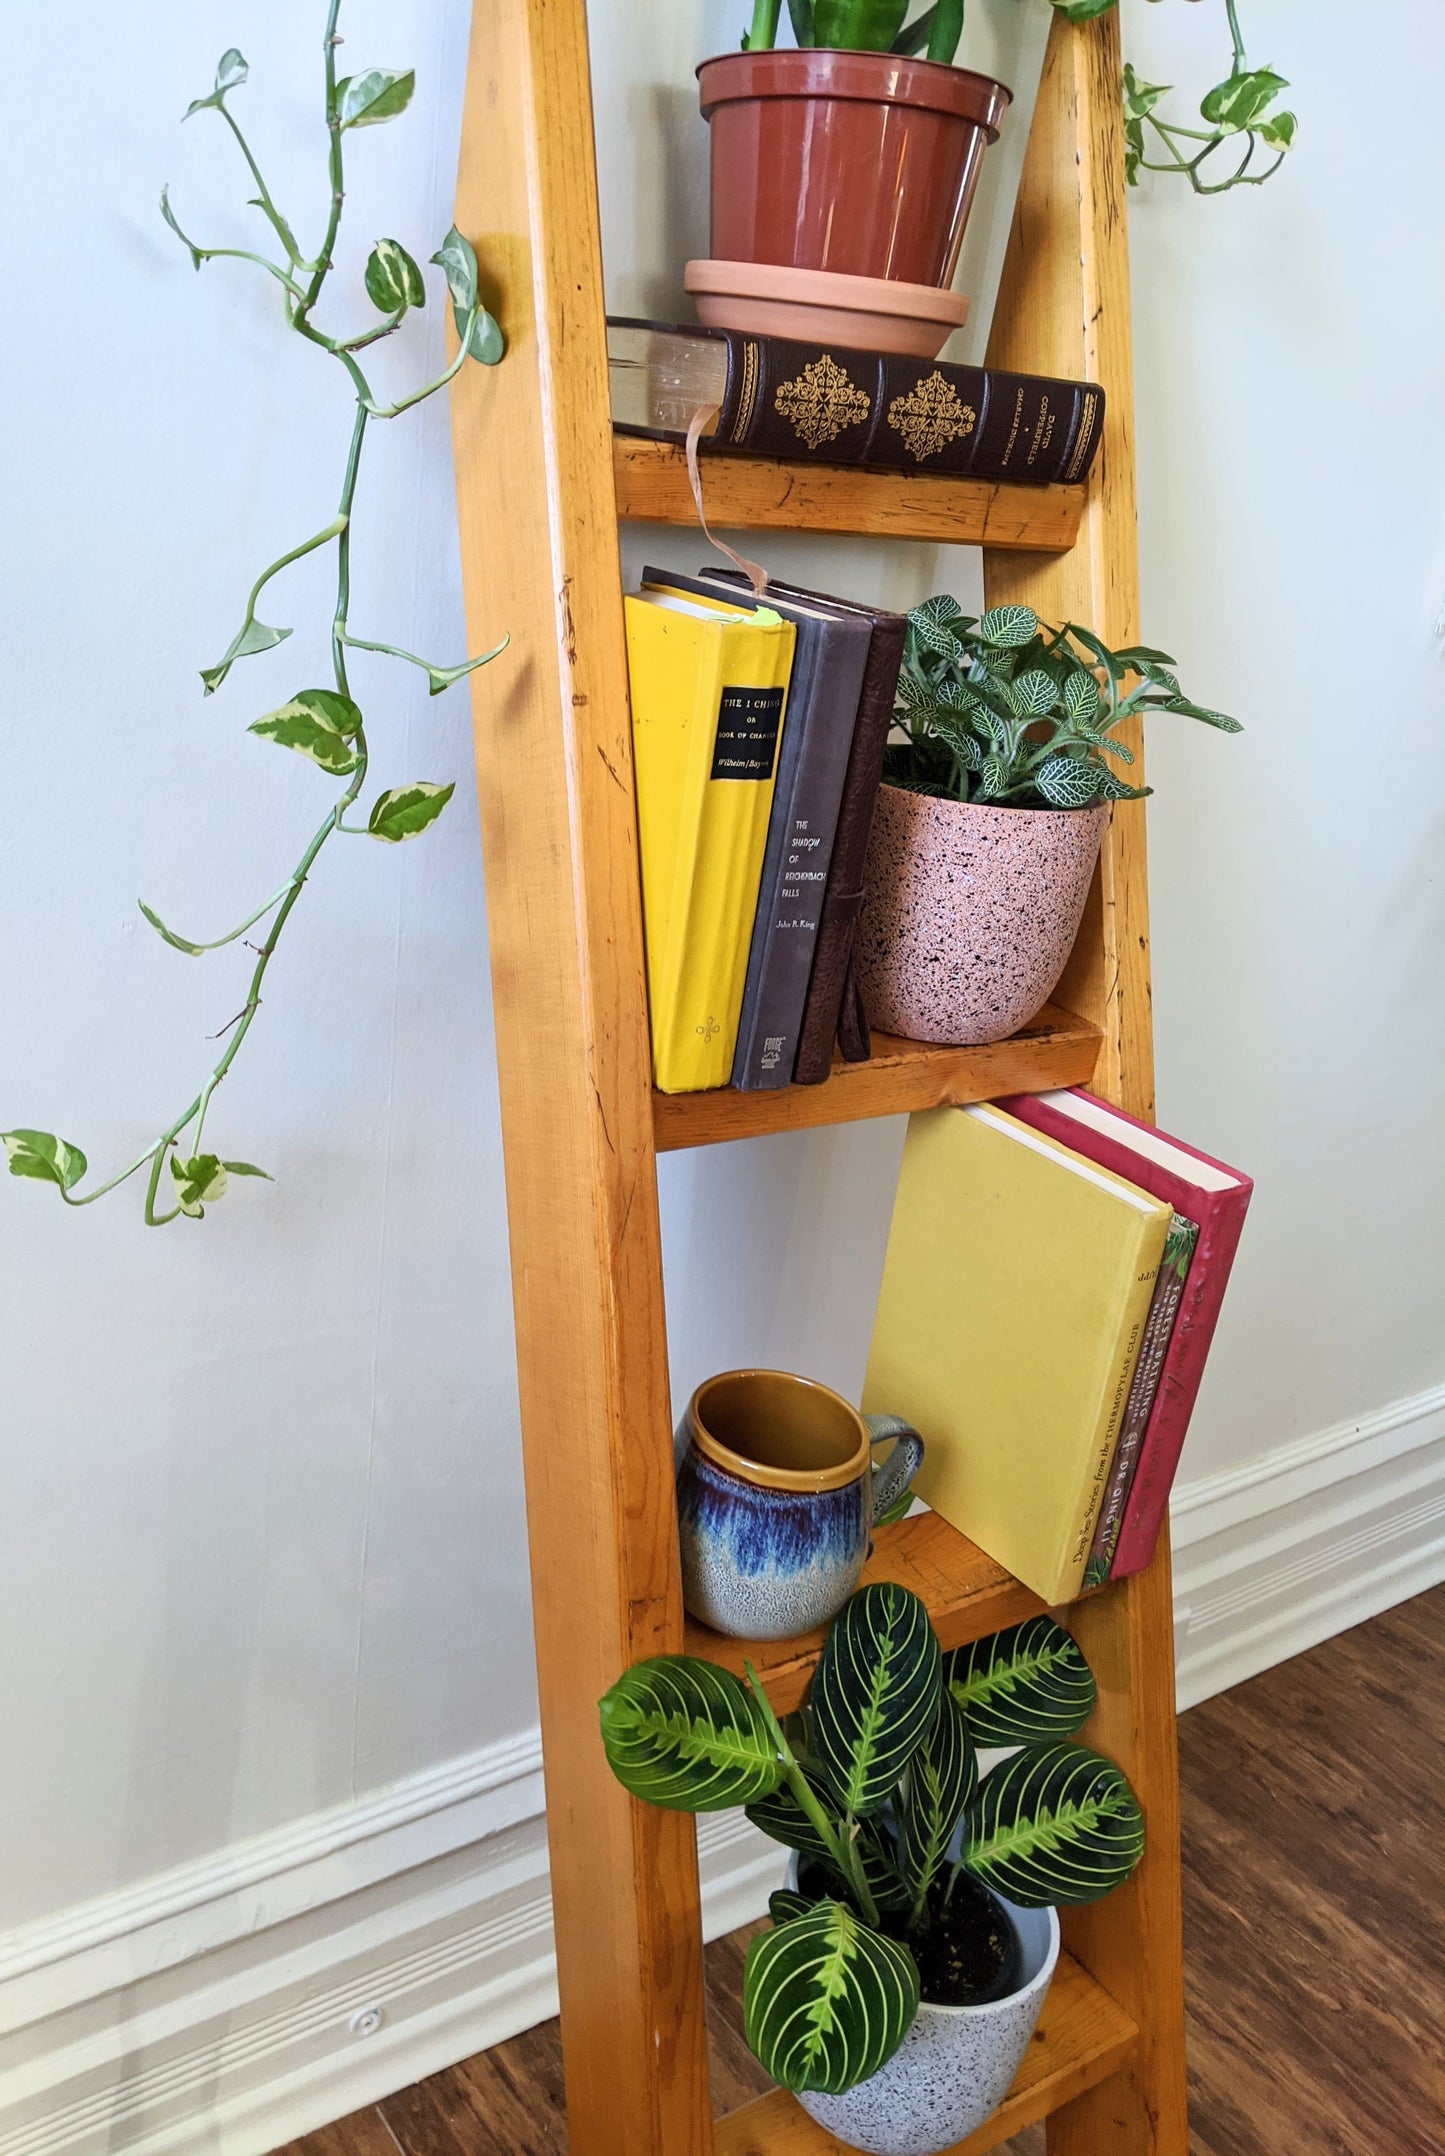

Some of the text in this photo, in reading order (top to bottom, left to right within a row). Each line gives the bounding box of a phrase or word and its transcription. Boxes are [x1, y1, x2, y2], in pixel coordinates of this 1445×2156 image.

[1028, 396, 1049, 465] COPPERFIELD
[1042, 415, 1056, 449] DAVID
[1001, 428, 1018, 466] DICKENS
[724, 699, 780, 709] THE I CHING
[746, 716, 756, 724] OR
[796, 821, 809, 829] THE
[792, 838, 821, 849] SHADOW
[789, 855, 799, 863] OF
[785, 872, 826, 881] REICHENBACH
[782, 889, 800, 897] FALLS
[776, 920, 791, 928] John
[800, 920, 816, 930] King
[1163, 1285, 1171, 1303] HOW
[1160, 1285, 1180, 1341] FOREST
[1140, 1350, 1163, 1417] BATHING
[1093, 1459, 1107, 1481] from
[1100, 1442, 1110, 1457] the
[1105, 1357, 1132, 1440] THERMOPYLAE
[1127, 1323, 1140, 1353] CLUB
[1106, 1488, 1122, 1524] QING
[1101, 1530, 1112, 1542] LI
